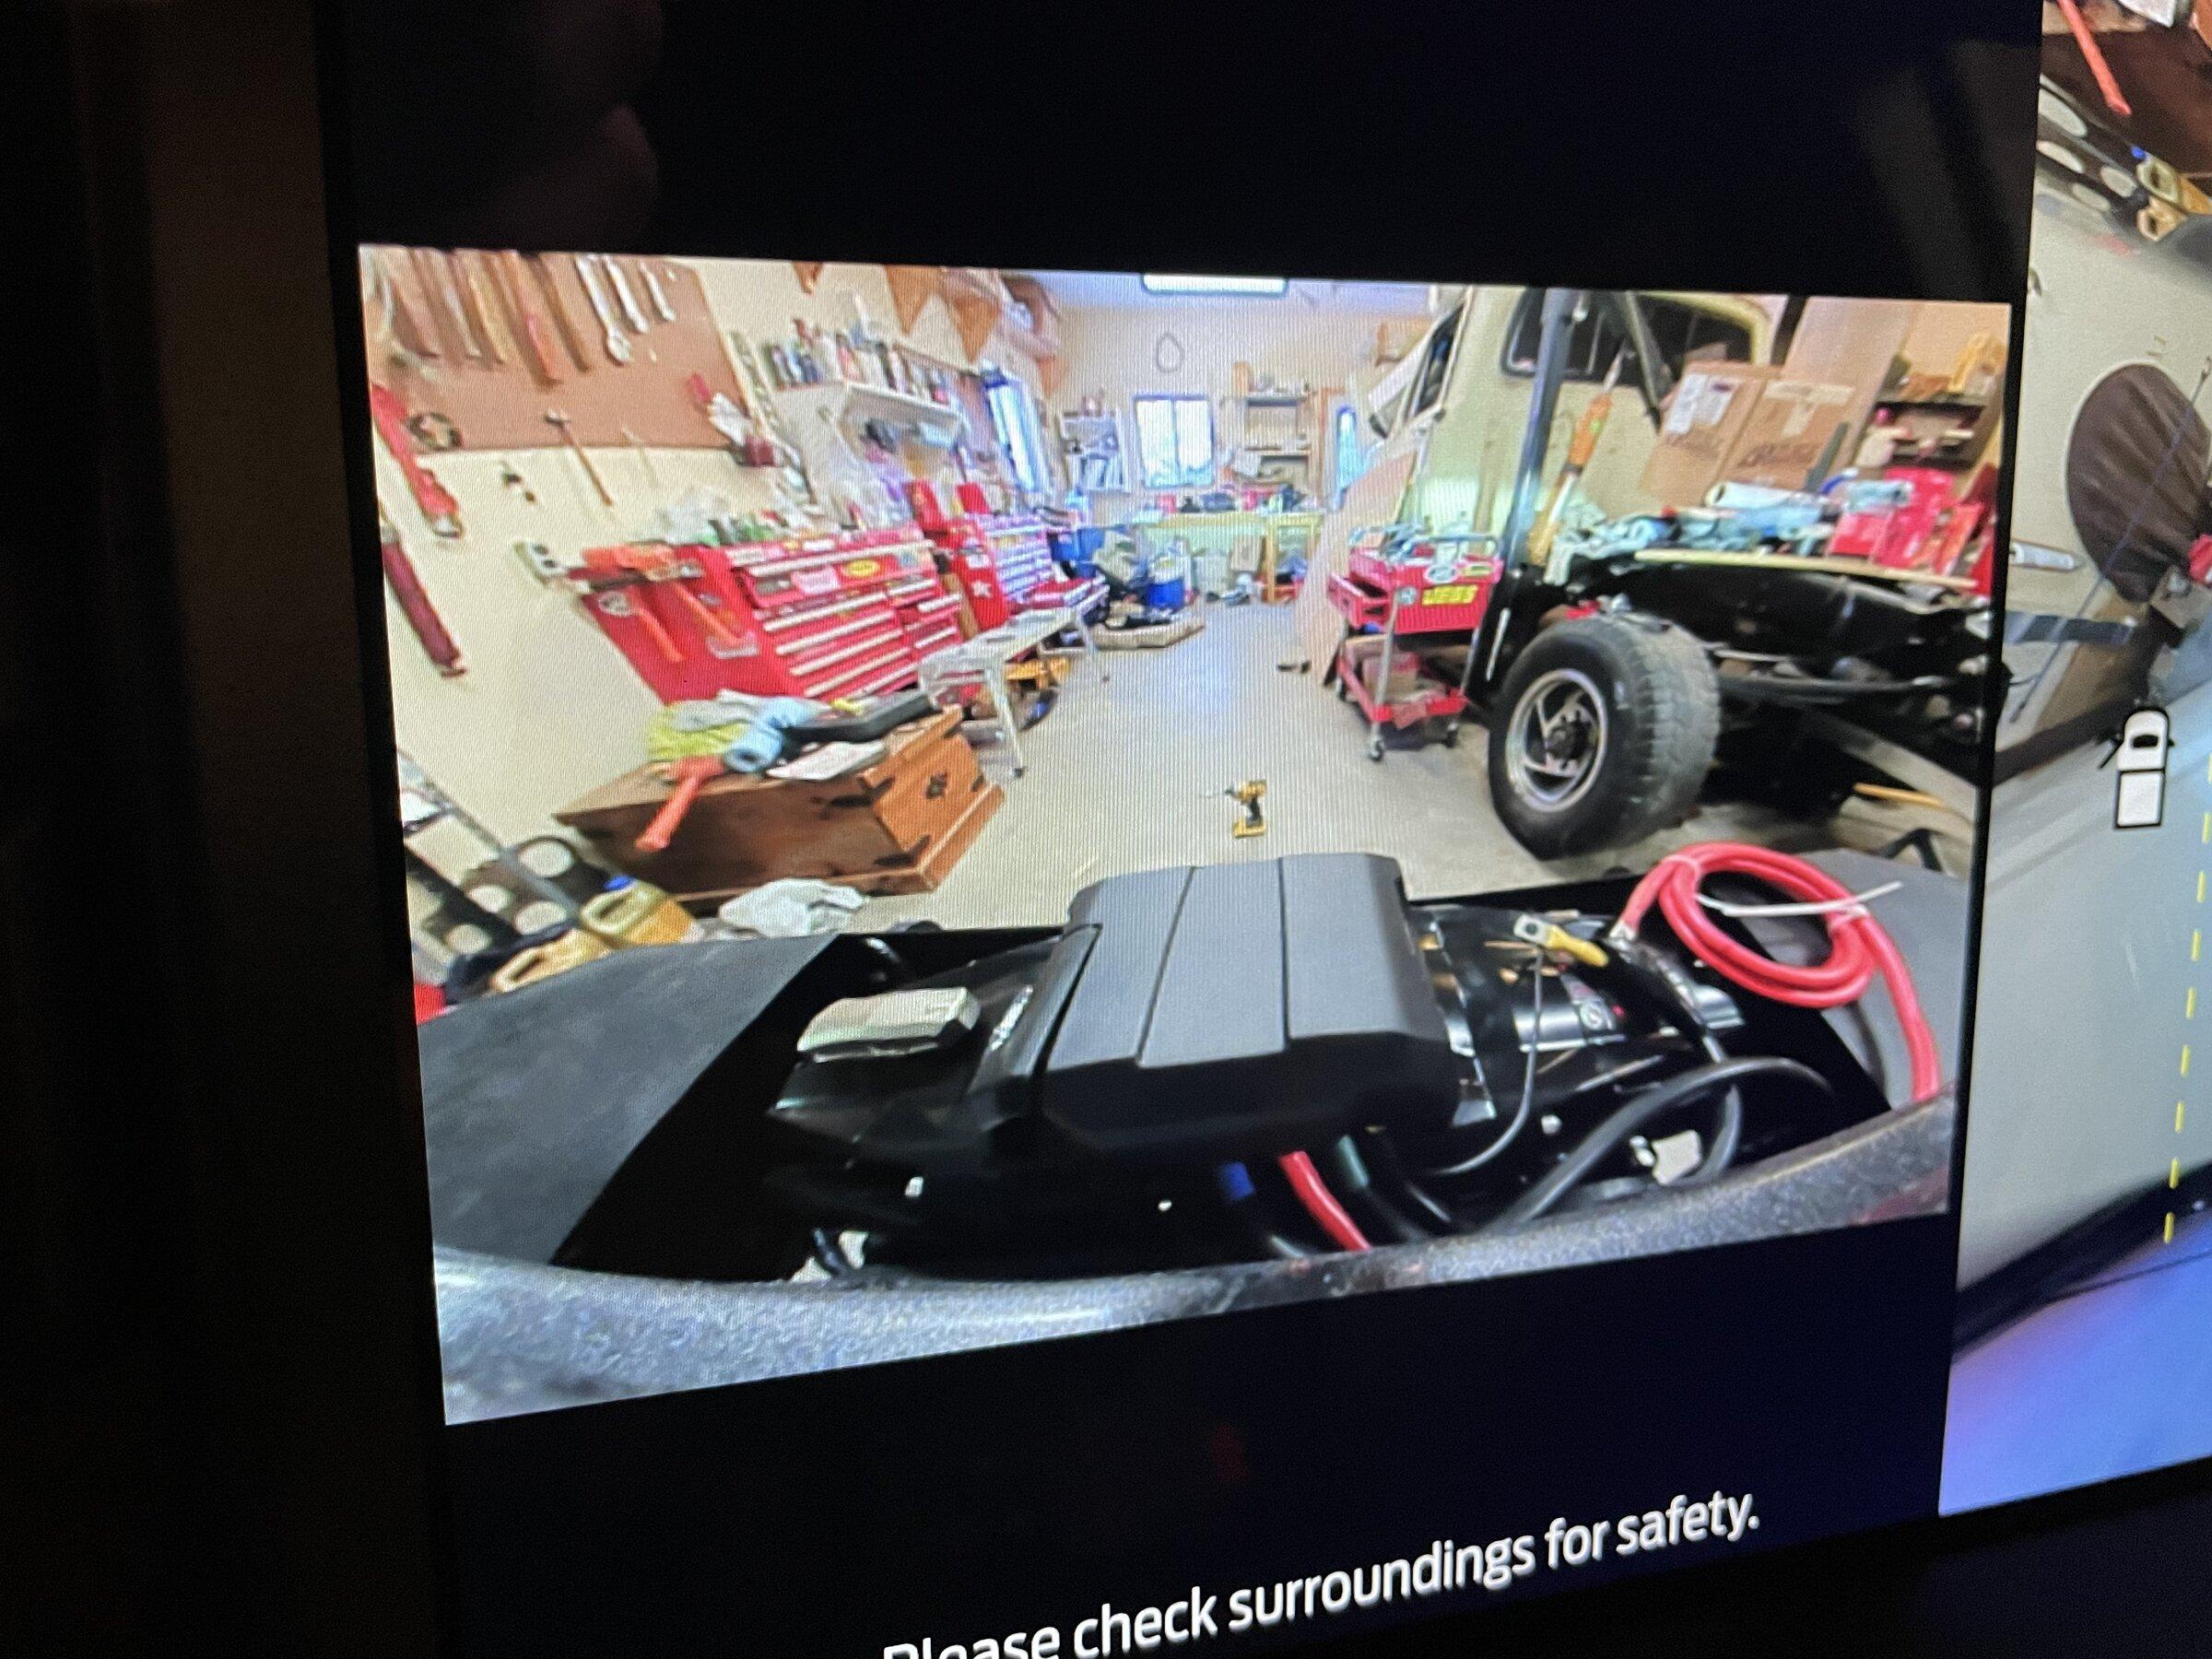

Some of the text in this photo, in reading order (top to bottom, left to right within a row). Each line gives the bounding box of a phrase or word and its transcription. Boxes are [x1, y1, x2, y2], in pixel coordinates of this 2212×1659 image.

[1074, 1586, 1218, 1659] check
[1229, 1535, 1536, 1631] surroundings
[1545, 1517, 1611, 1570] for
[1616, 1490, 1760, 1556] safety.
